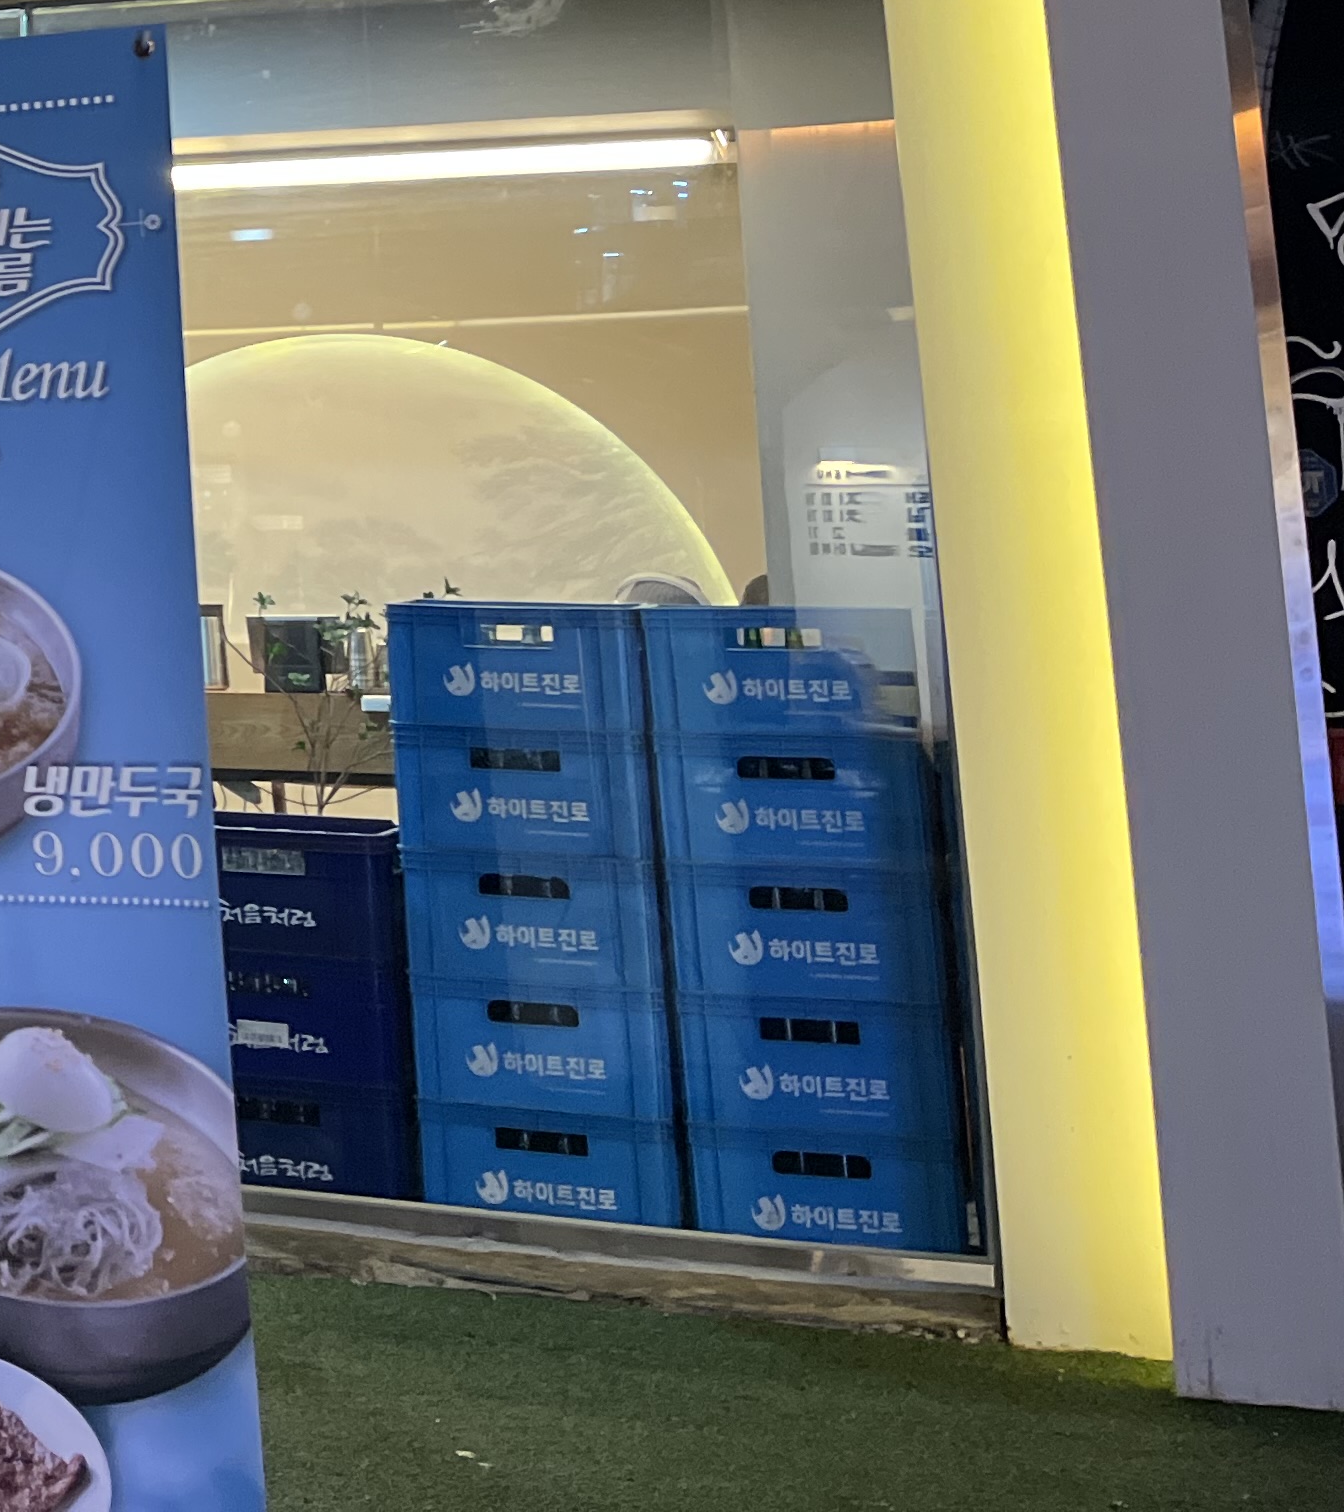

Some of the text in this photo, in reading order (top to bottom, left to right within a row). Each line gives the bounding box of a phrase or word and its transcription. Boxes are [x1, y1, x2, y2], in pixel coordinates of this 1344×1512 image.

[480, 671, 582, 695] 하이트진로
[742, 678, 853, 702] 하이트진로
[23, 763, 203, 819] 냉만두국
[487, 796, 590, 823] 하이트진로
[754, 806, 865, 833] 하이트진로
[32, 830, 204, 880] 9.000
[495, 923, 599, 952] 하이트진로
[768, 938, 880, 966] 하이트진로
[503, 1051, 606, 1080] 하이트진로
[779, 1073, 890, 1101] 하이트진로
[513, 1179, 617, 1210] 하이트진로
[791, 1203, 902, 1233] 하이트진로
